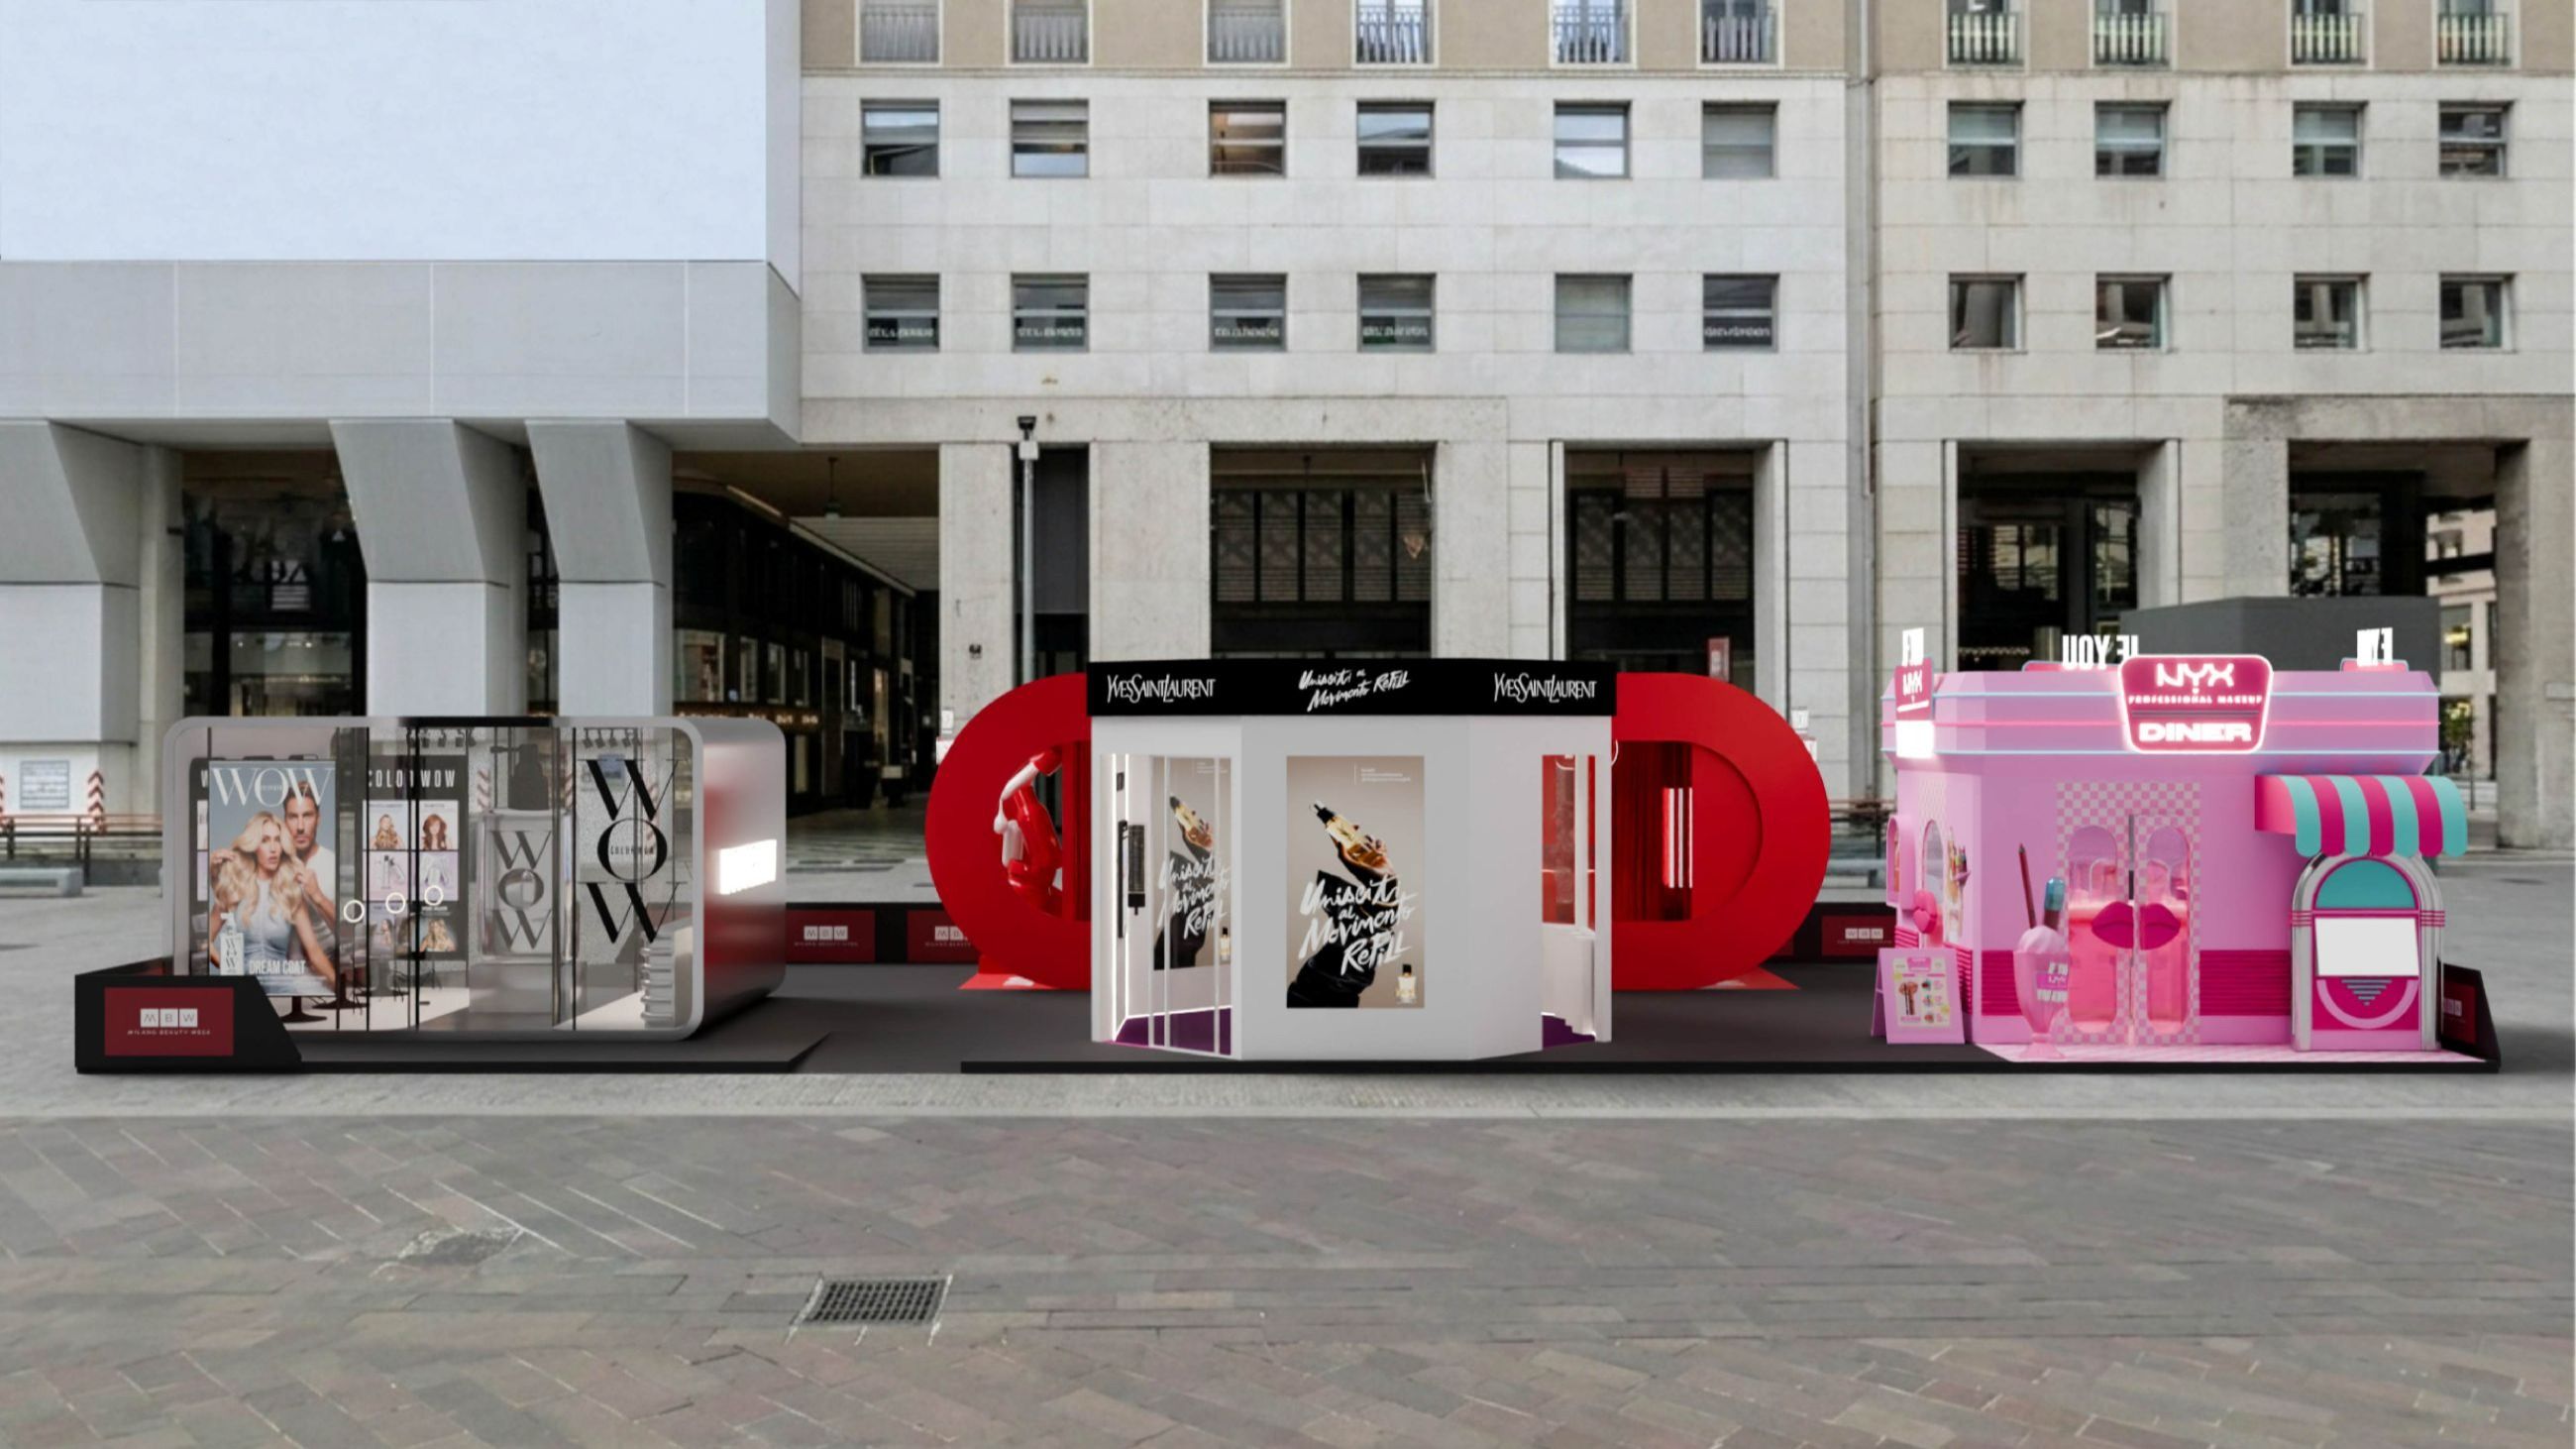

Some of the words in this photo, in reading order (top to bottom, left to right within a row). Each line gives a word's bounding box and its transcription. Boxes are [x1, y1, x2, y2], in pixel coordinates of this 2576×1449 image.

[2156, 663, 2234, 692] NYX
[2128, 695, 2212, 705] PROFESSIONAL
[2216, 695, 2263, 705] MAKEUP
[2138, 723, 2252, 742] DINER
[211, 767, 336, 808] WOW
